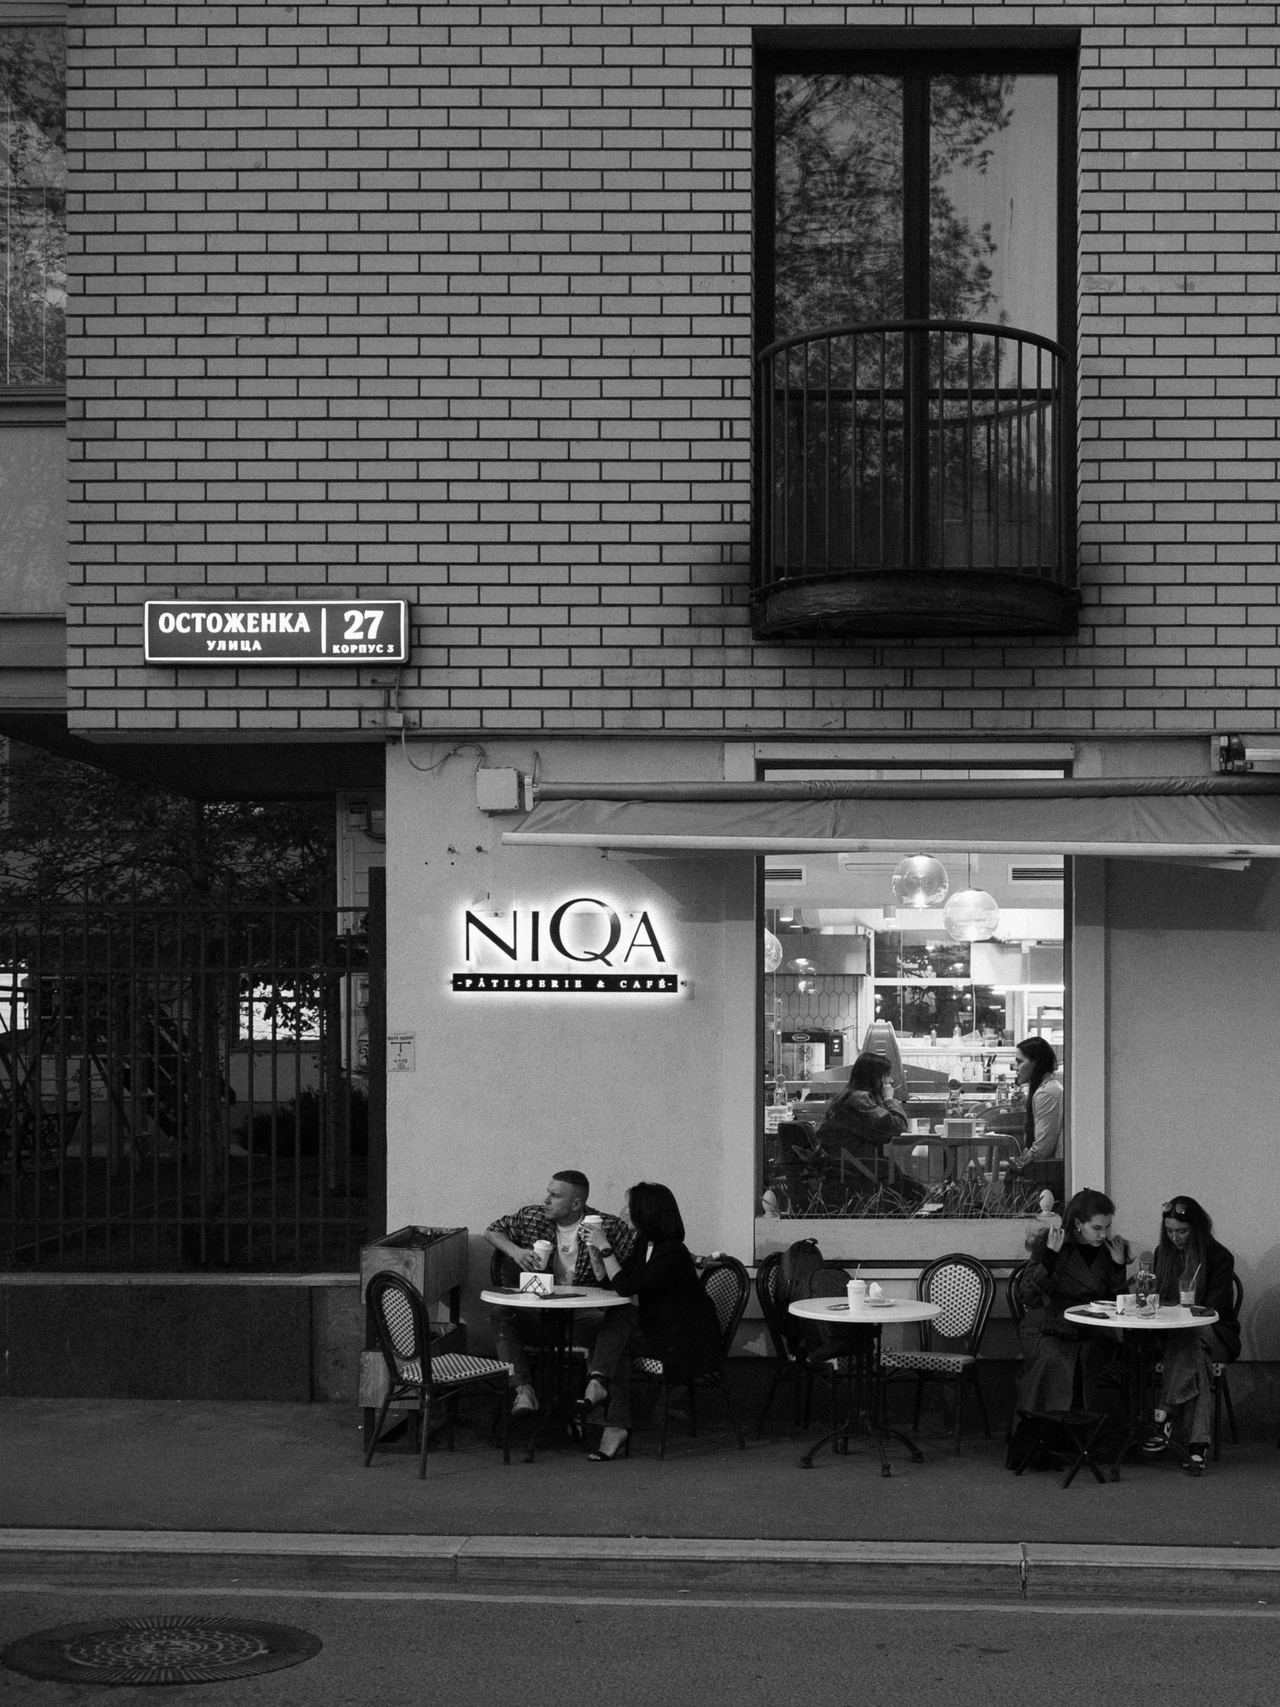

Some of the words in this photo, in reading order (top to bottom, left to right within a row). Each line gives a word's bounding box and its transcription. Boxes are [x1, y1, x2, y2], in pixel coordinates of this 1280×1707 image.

[158, 612, 311, 633] ОСТОЖЕНКА
[343, 610, 384, 640] 27
[206, 640, 262, 652] УЛИЦА
[332, 644, 384, 654] КОРПУС
[386, 644, 395, 654] 3
[465, 897, 666, 967] NIQA
[597, 979, 605, 989] &
